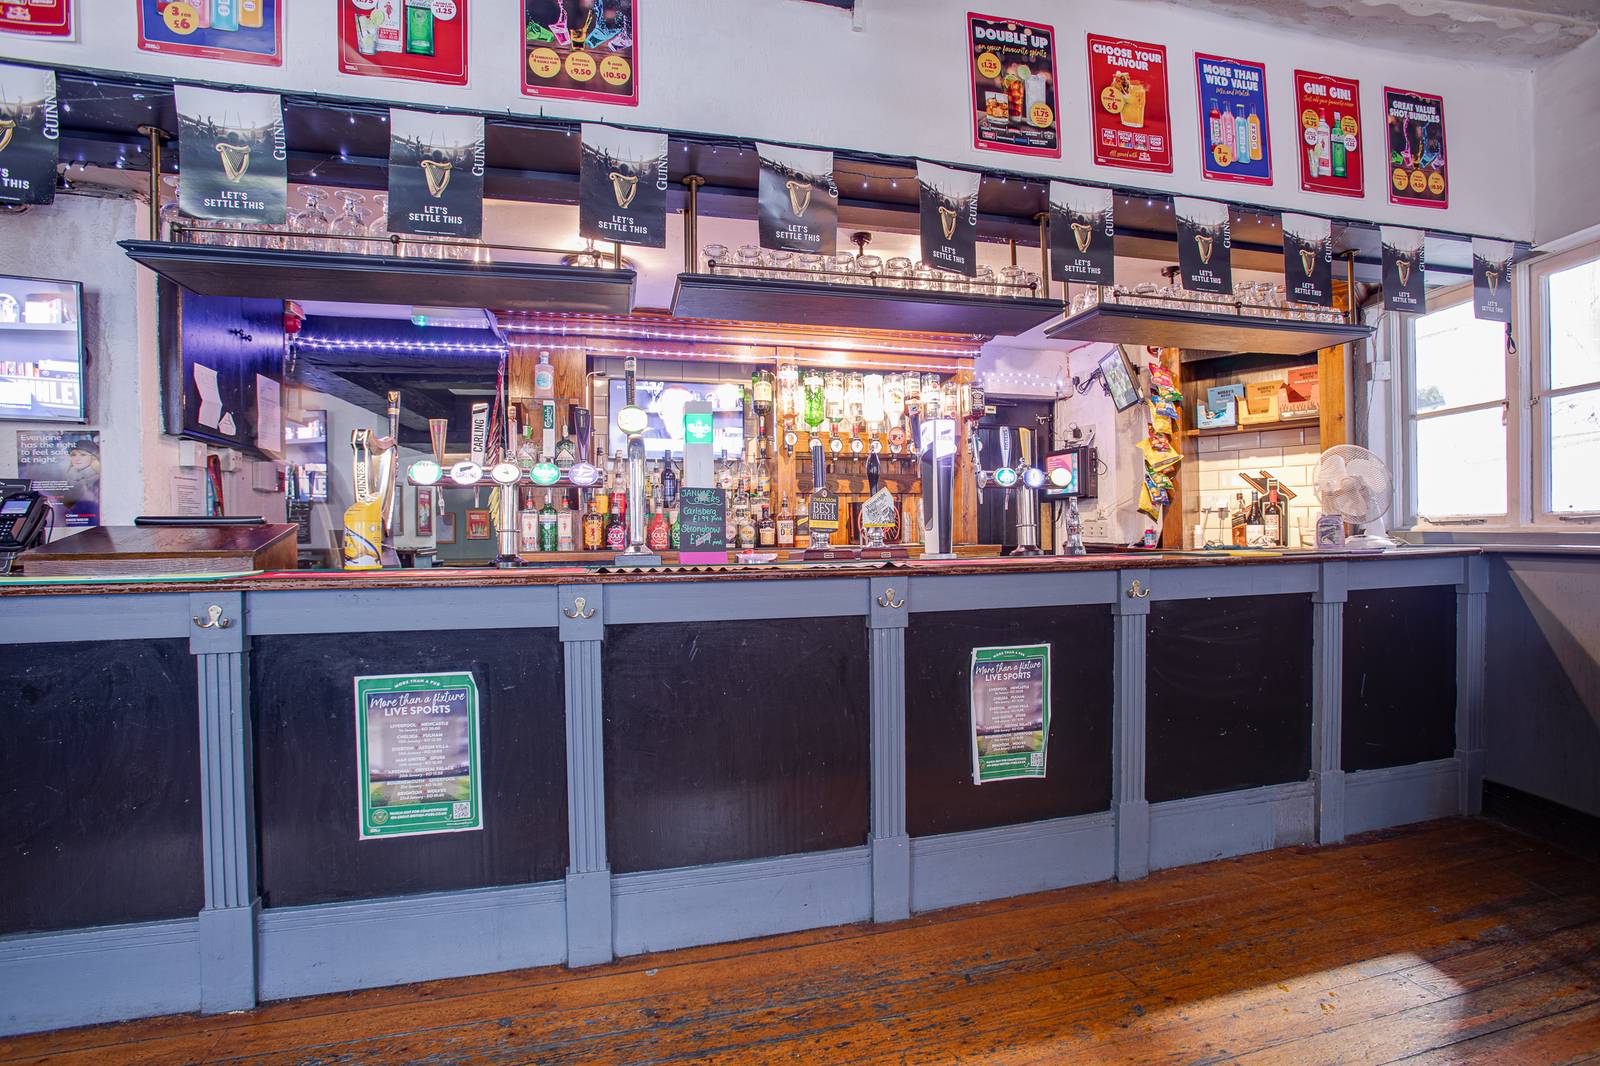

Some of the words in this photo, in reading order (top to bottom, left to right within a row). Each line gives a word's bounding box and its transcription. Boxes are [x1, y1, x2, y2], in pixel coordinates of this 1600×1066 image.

[172, 6, 179, 16] 3
[174, 18, 190, 30] £6
[975, 26, 1027, 46] DOUBLE
[1030, 36, 1048, 48] UP
[1093, 44, 1132, 58] CHOOSE
[1135, 50, 1162, 63] YOUR
[1107, 55, 1149, 71] FLAVOUR
[1203, 64, 1232, 78] MORE
[1233, 69, 1258, 81] THAN
[1205, 74, 1228, 86] WKD
[1231, 78, 1258, 91] VALUE
[1109, 89, 1115, 97] 2
[1304, 82, 1326, 96] GIN!
[1329, 87, 1351, 101] GIN!
[1392, 100, 1413, 111] GREAT
[1414, 104, 1436, 114] VALUE
[1390, 108, 1408, 118] SHOT
[1408, 112, 1440, 123] BUNDLES
[2, 178, 30, 190] THIS
[221, 191, 248, 200] LET'S
[204, 199, 240, 209] SETTLE
[243, 201, 265, 210] THIS
[424, 205, 448, 215] LET'S
[409, 213, 440, 223] SETTLE
[443, 215, 463, 224] THIS
[612, 215, 634, 225] LET'S
[598, 221, 627, 232] SETTLE
[629, 225, 648, 234] THIS
[775, 231, 803, 240] SETTLE
[805, 234, 820, 242] THIS
[941, 245, 956, 255] LET'S
[933, 251, 952, 261] SETTLE
[953, 255, 965, 264] THIS
[1064, 265, 1086, 273] SETTLE
[1192, 275, 1209, 283] SETTLE
[1295, 287, 1311, 295] SETTLE
[473, 419, 485, 453] CARLING
[56, 442, 77, 450] right
[683, 507, 716, 515] Carlsberg
[813, 502, 835, 514] BEST
[681, 523, 720, 535] Strongbow
[976, 665, 996, 675] More
[996, 662, 1012, 673] than
[1019, 660, 1041, 673] fixture
[1003, 672, 1031, 681] SPORTS
[370, 698, 400, 709] More
[400, 693, 423, 707] than
[432, 691, 465, 707] fixture
[385, 707, 407, 717] LIVE
[410, 705, 451, 715] SPORTS
